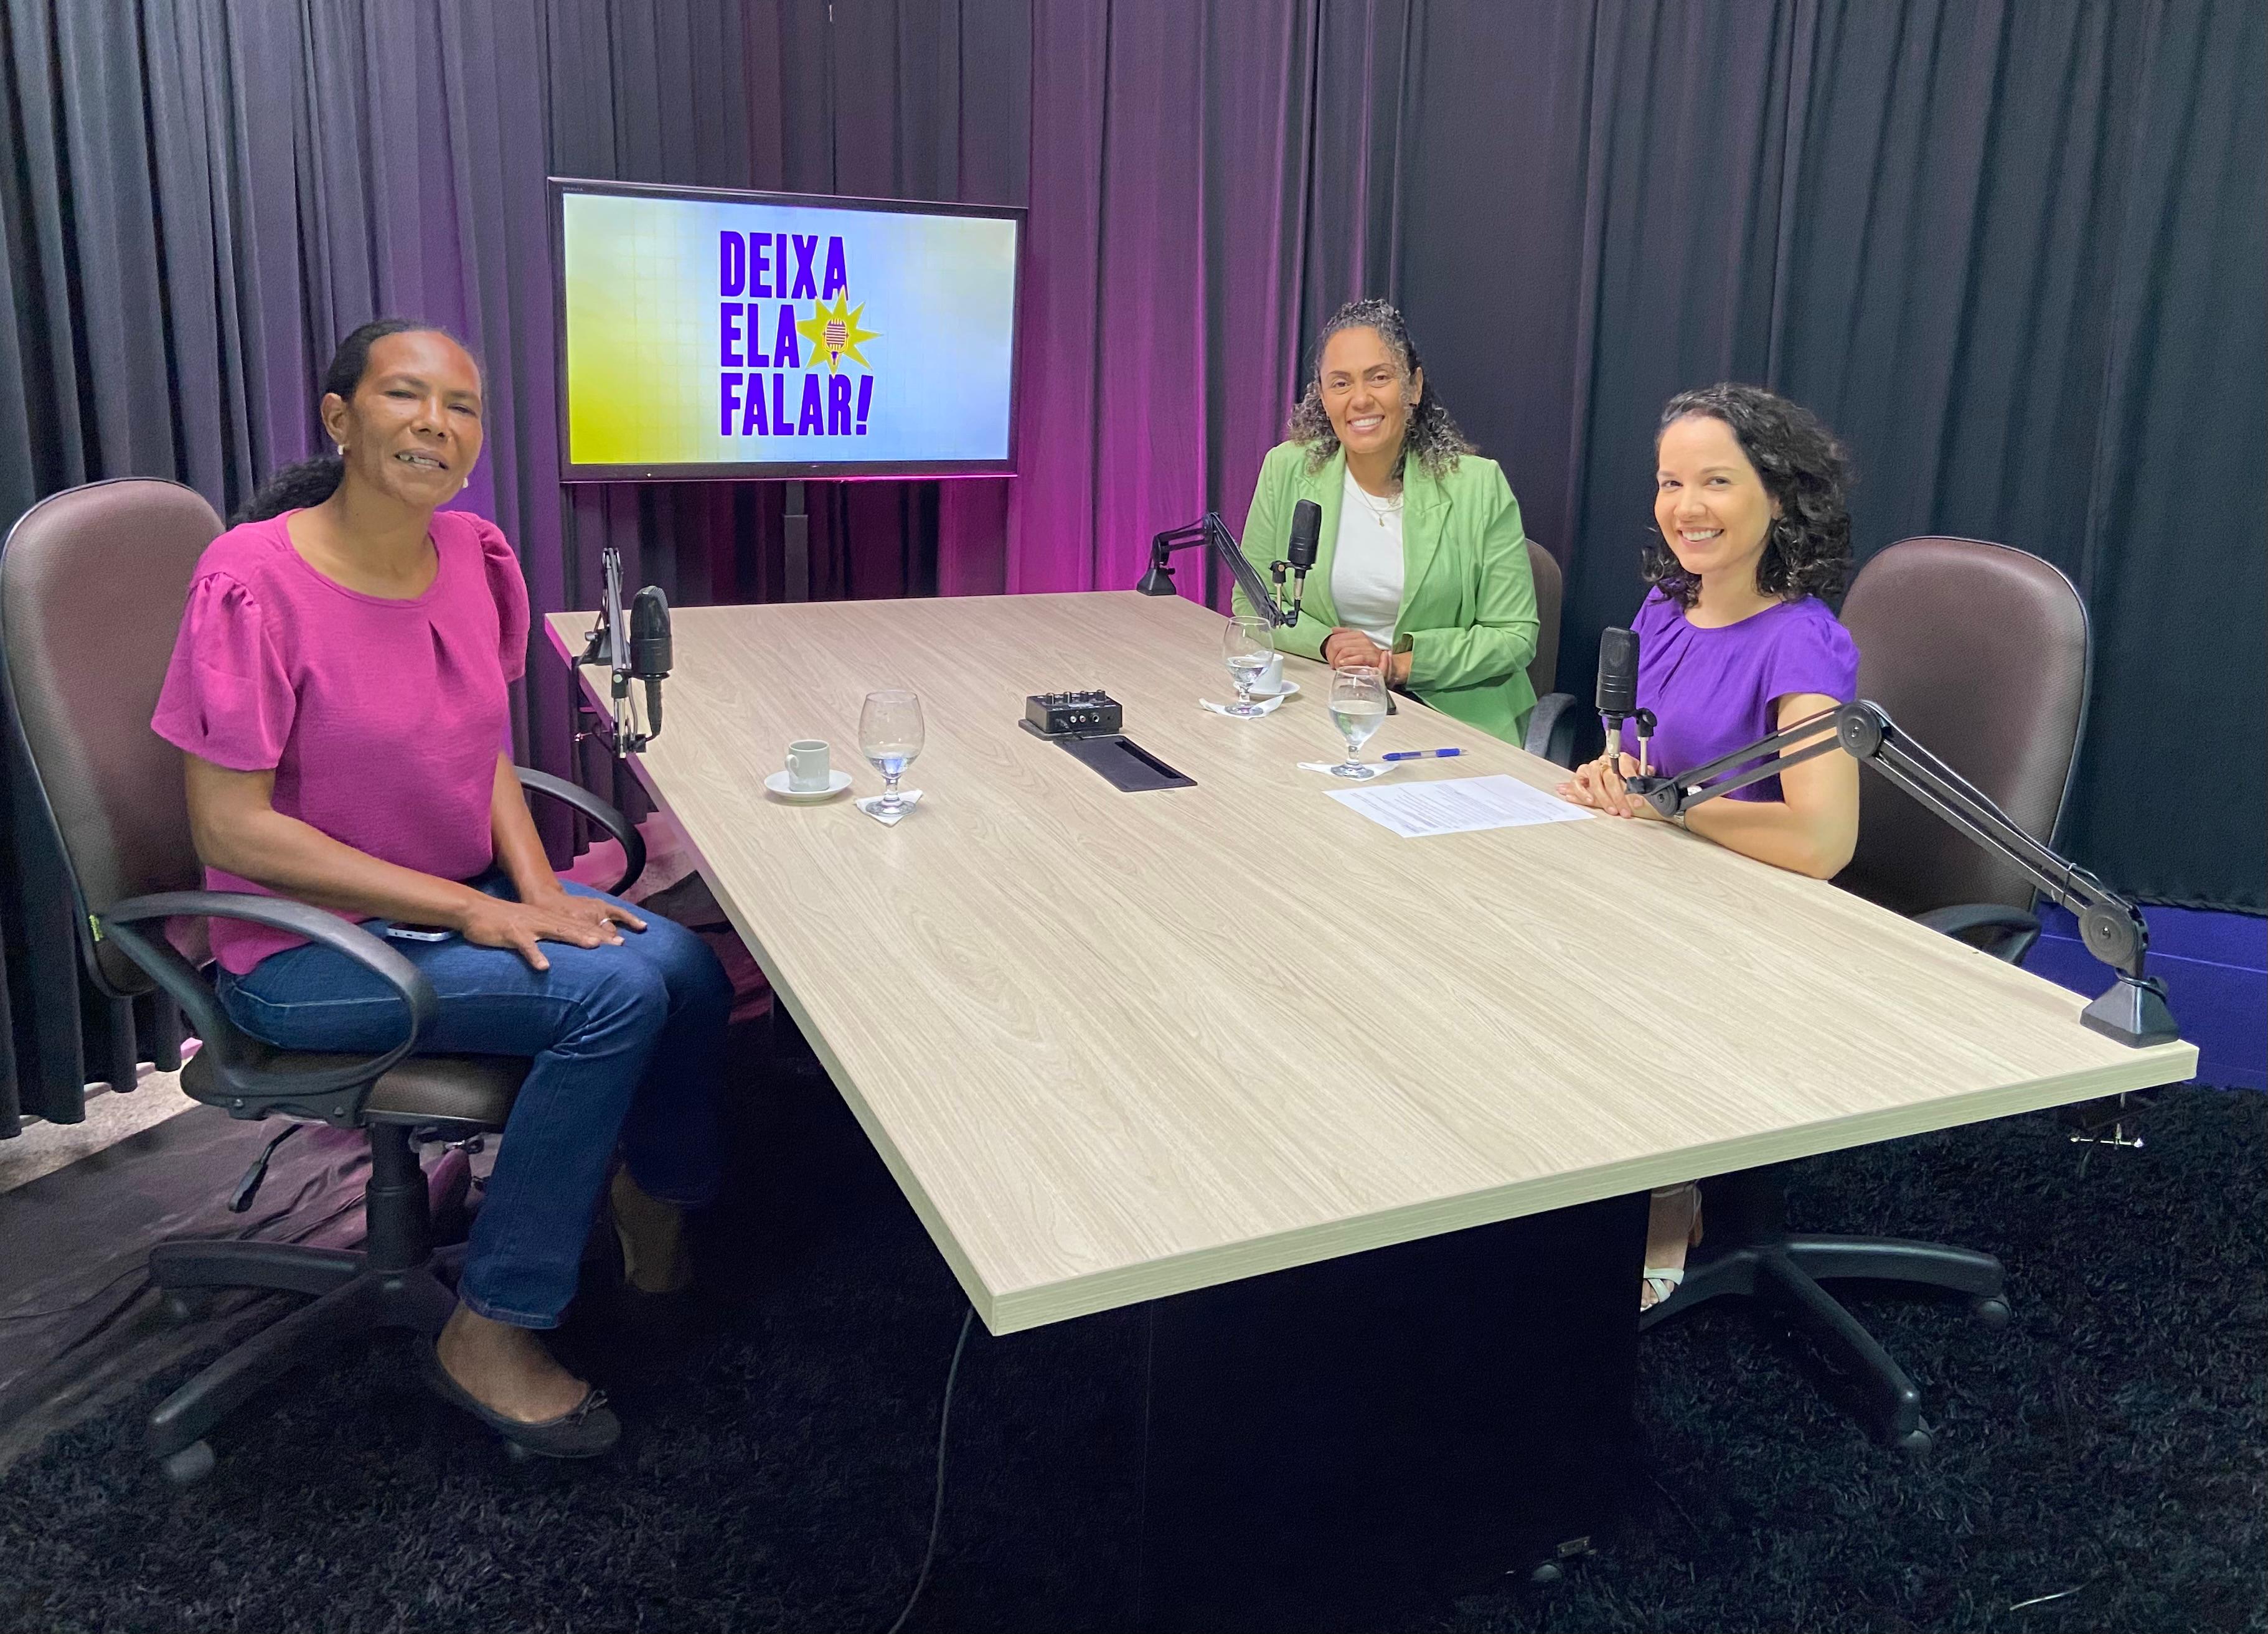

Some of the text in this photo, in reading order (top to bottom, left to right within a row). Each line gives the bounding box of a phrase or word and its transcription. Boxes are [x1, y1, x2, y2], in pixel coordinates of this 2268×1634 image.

[720, 230, 848, 301] DEIXA
[720, 301, 801, 369] ELA
[720, 372, 874, 436] FALAR!
